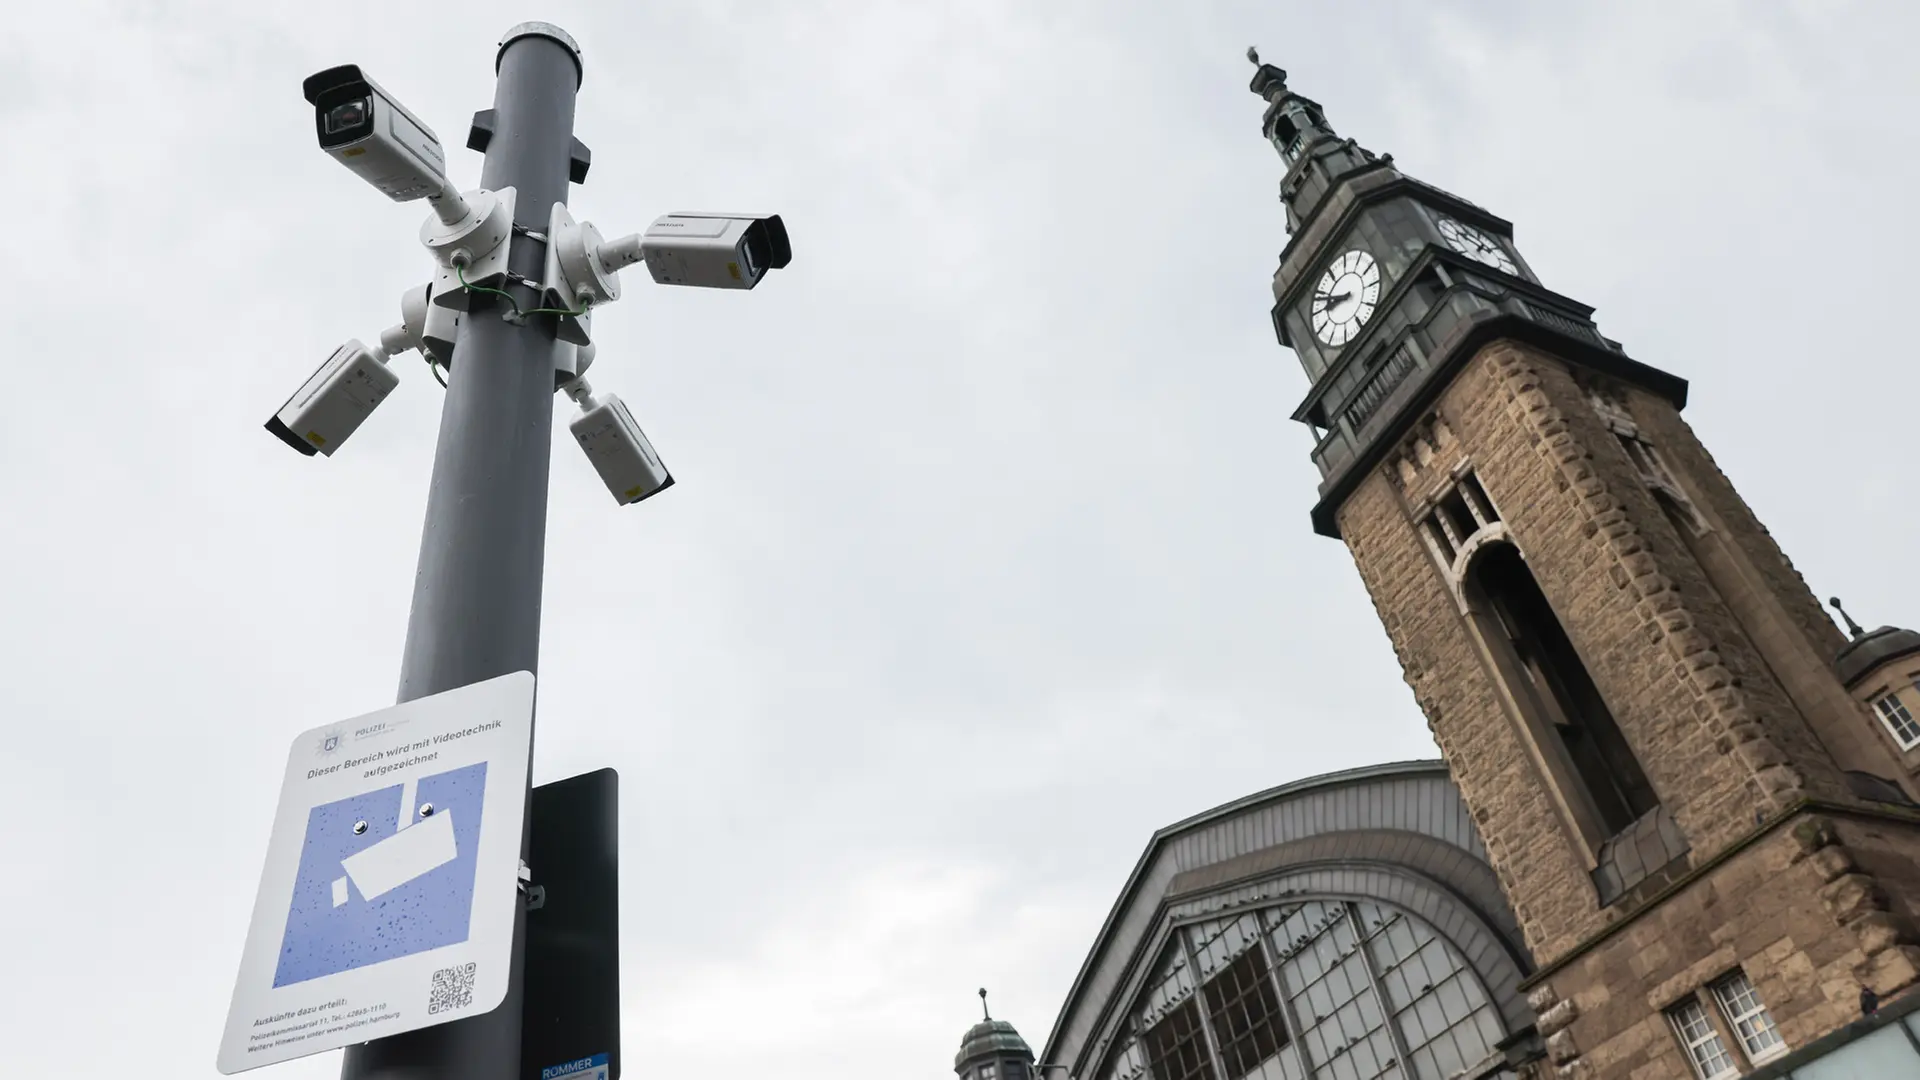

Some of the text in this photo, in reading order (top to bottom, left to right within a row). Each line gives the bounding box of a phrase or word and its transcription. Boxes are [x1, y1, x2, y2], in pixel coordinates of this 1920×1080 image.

[355, 723, 386, 737] POLIZEI
[307, 719, 502, 780] Dieser Bereich wird mit Videotechnik
[363, 751, 439, 779] aufgezeichnet
[253, 998, 348, 1028] Auskünfte dazu erteilt:
[247, 1042, 274, 1053] Weitere
[275, 1035, 306, 1047] Hinweise
[306, 1029, 325, 1039] unter
[543, 1058, 592, 1079] ROMMER
